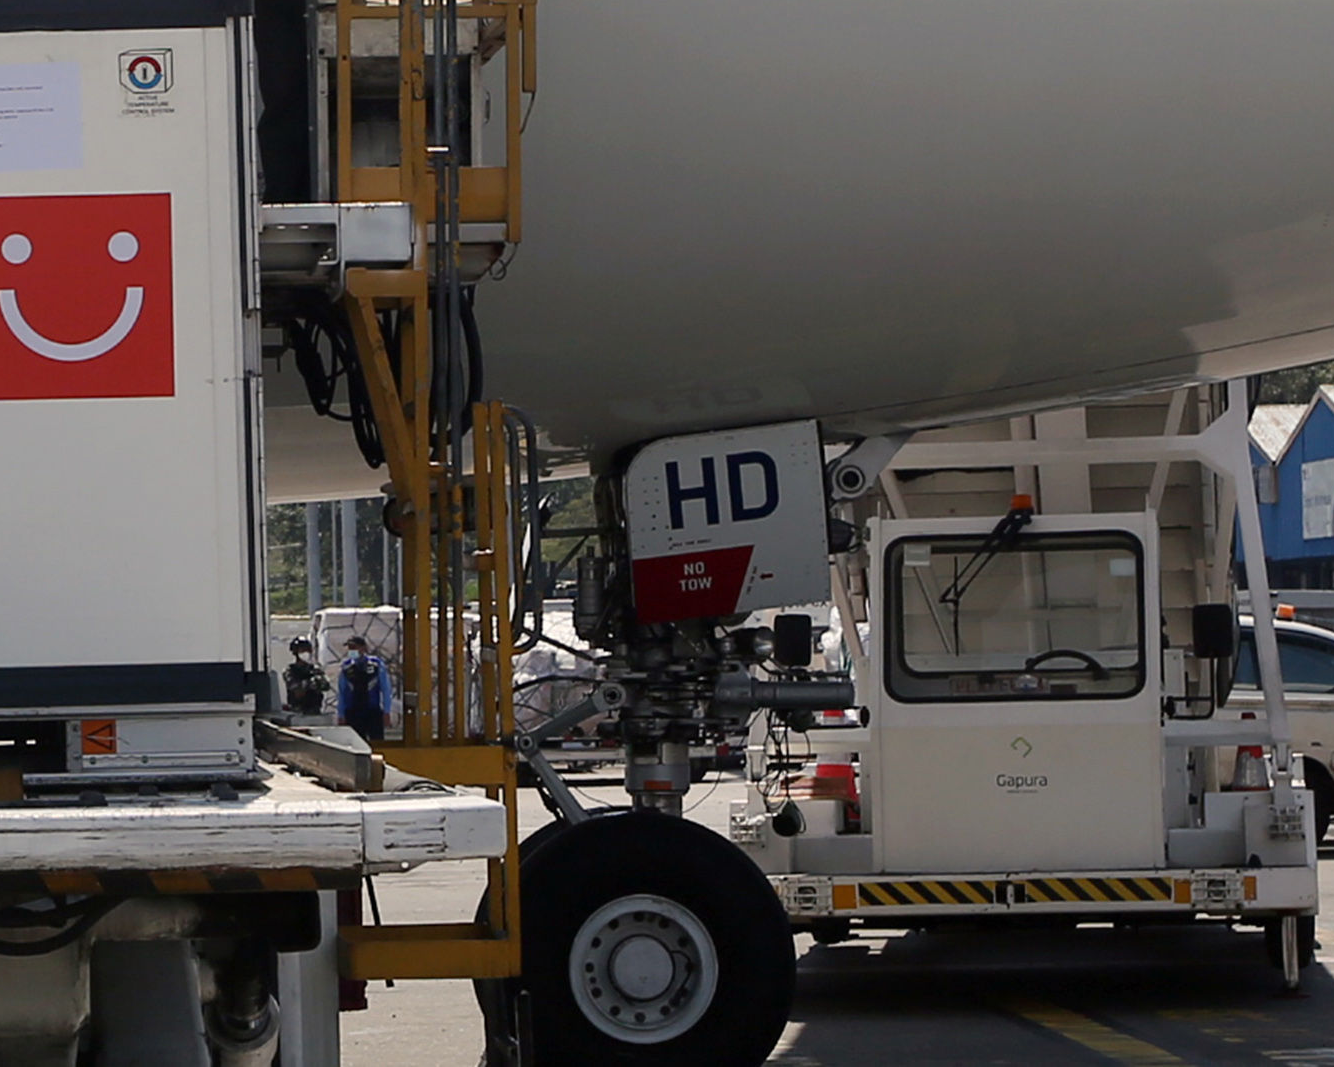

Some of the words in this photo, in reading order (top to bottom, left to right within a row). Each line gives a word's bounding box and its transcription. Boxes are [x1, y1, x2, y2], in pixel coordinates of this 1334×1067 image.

[665, 451, 780, 530] HD
[684, 561, 705, 575] NO
[679, 577, 713, 593] TOW
[996, 774, 1048, 789] Gapura
